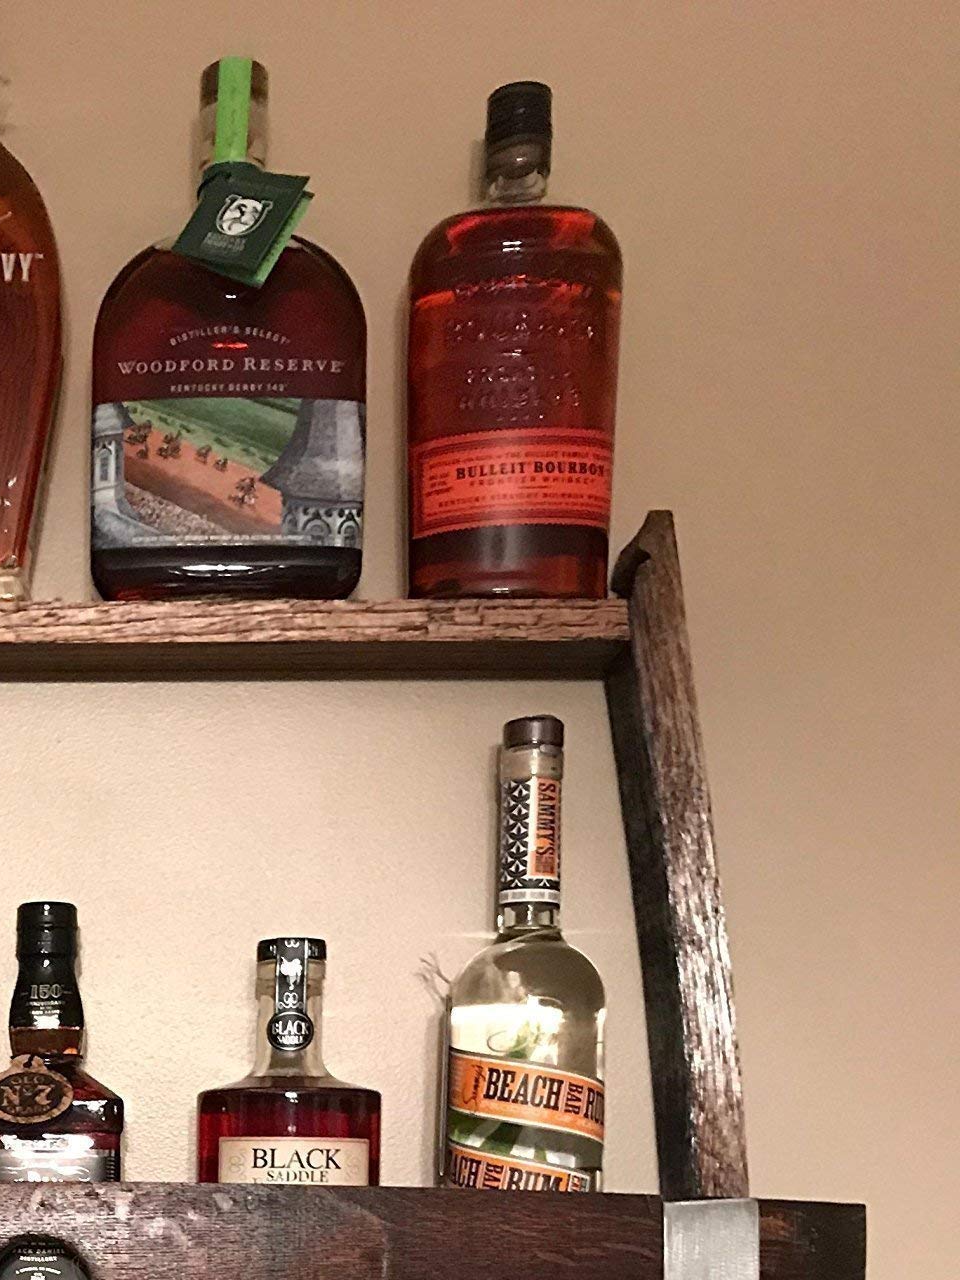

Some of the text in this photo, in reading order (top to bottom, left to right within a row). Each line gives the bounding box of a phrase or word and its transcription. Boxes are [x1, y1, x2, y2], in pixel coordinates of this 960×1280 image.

[117, 356, 344, 375] WOODFORD RESERVE
[170, 384, 224, 393] KENTUCKY
[228, 383, 263, 392] DERBY
[456, 463, 527, 480] BULLEIT
[533, 461, 605, 476] BOURBON
[536, 783, 556, 856] SAMMY'S
[272, 1020, 308, 1035] BLACK
[483, 1067, 565, 1111] BEACH
[564, 1081, 584, 1116] BAR
[251, 1148, 342, 1169] BLACK
[266, 1170, 329, 1183] SADDLE
